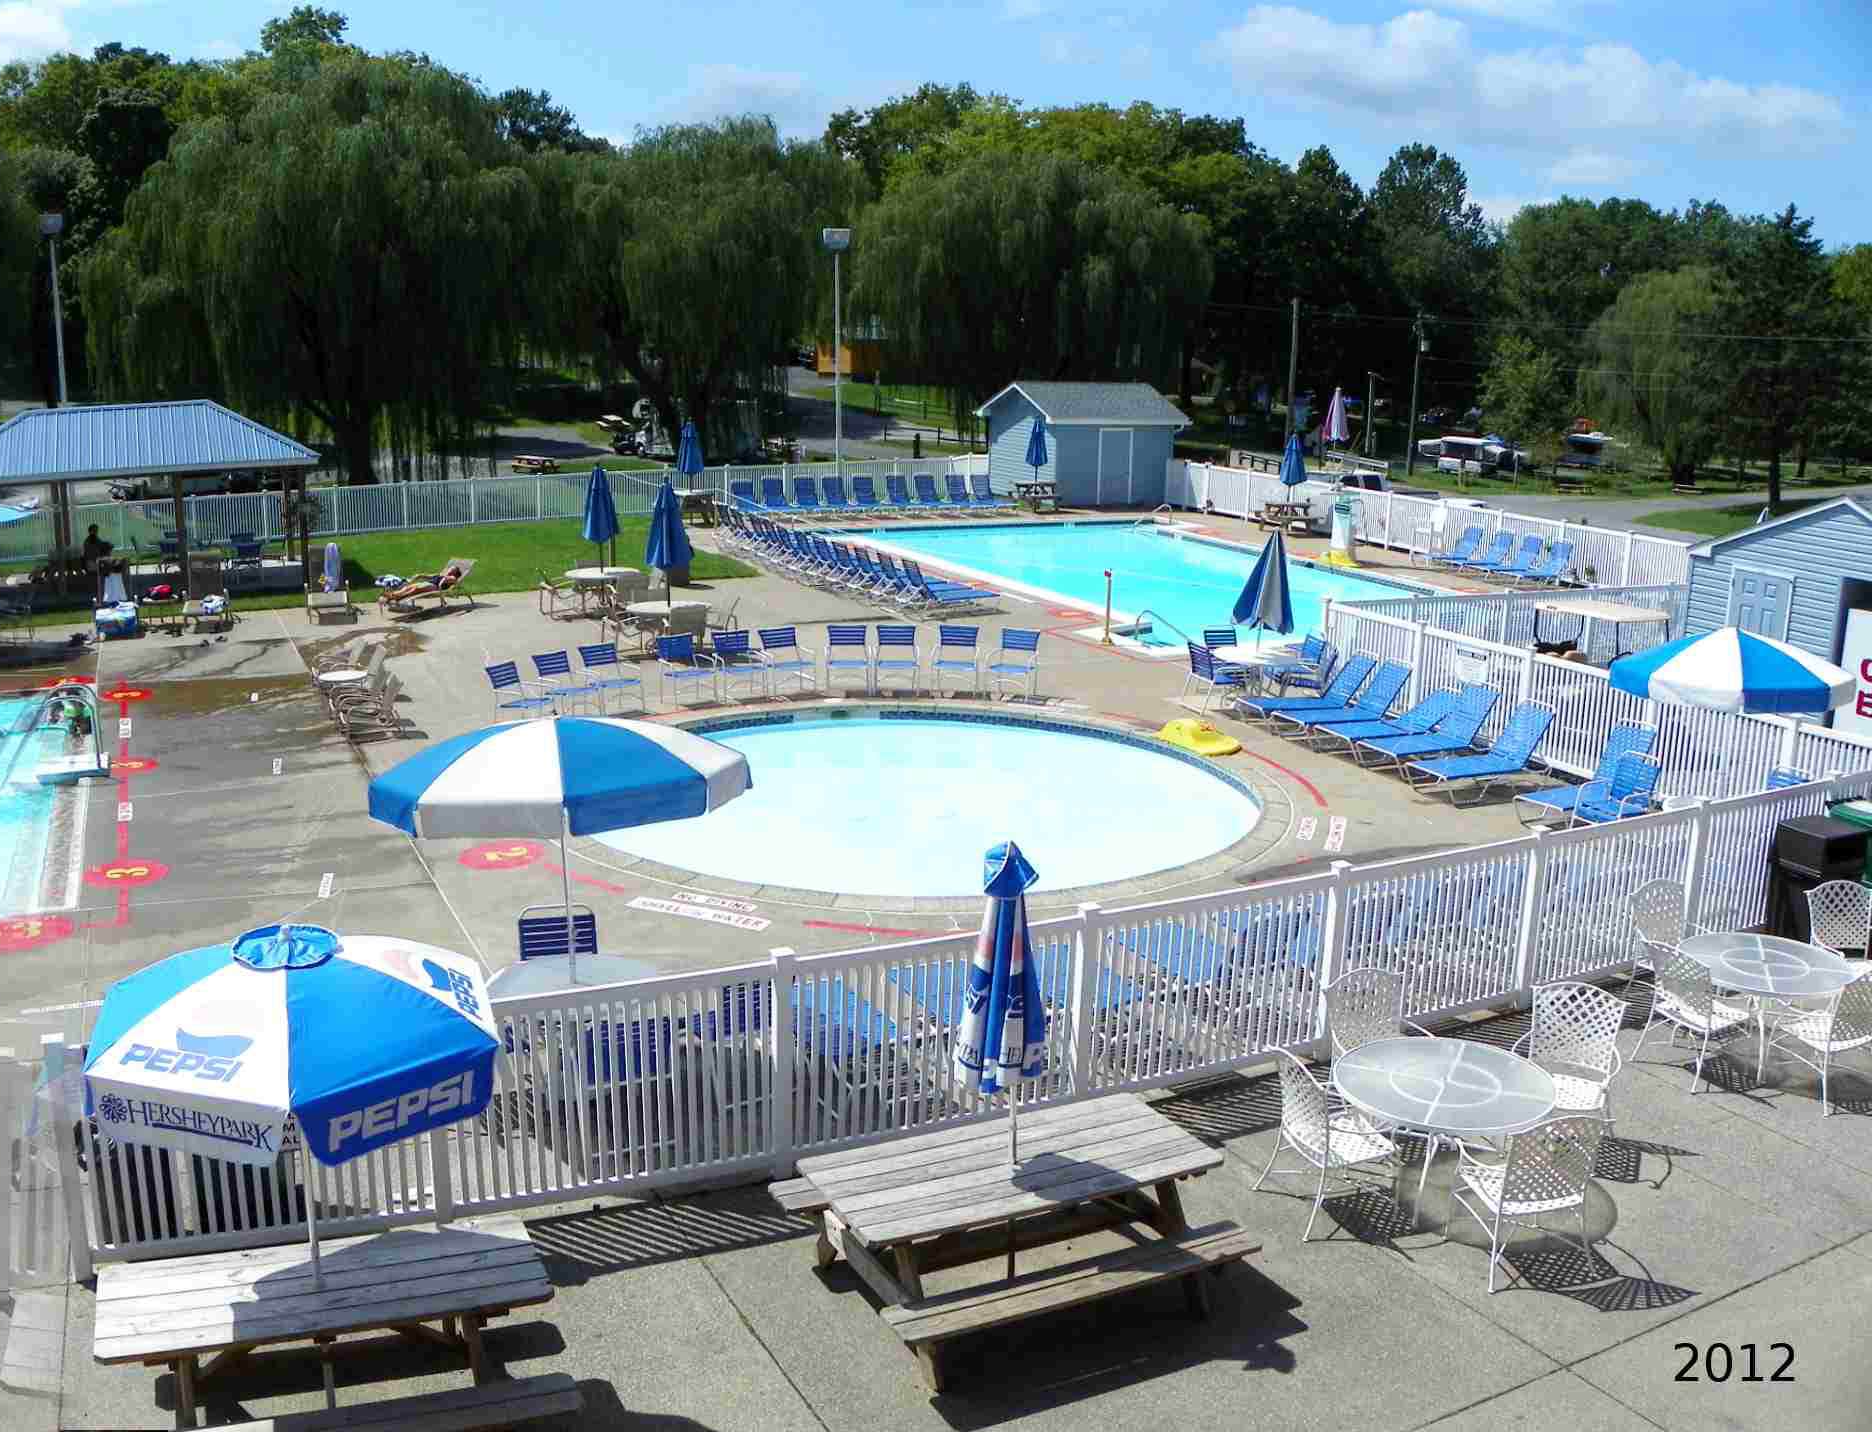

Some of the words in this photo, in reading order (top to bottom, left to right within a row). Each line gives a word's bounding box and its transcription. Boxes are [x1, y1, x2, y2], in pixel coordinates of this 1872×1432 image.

[120, 1043, 243, 1083] PEPSI
[128, 1099, 273, 1151] HERSHEYPARK
[328, 1071, 475, 1152] PEPSI
